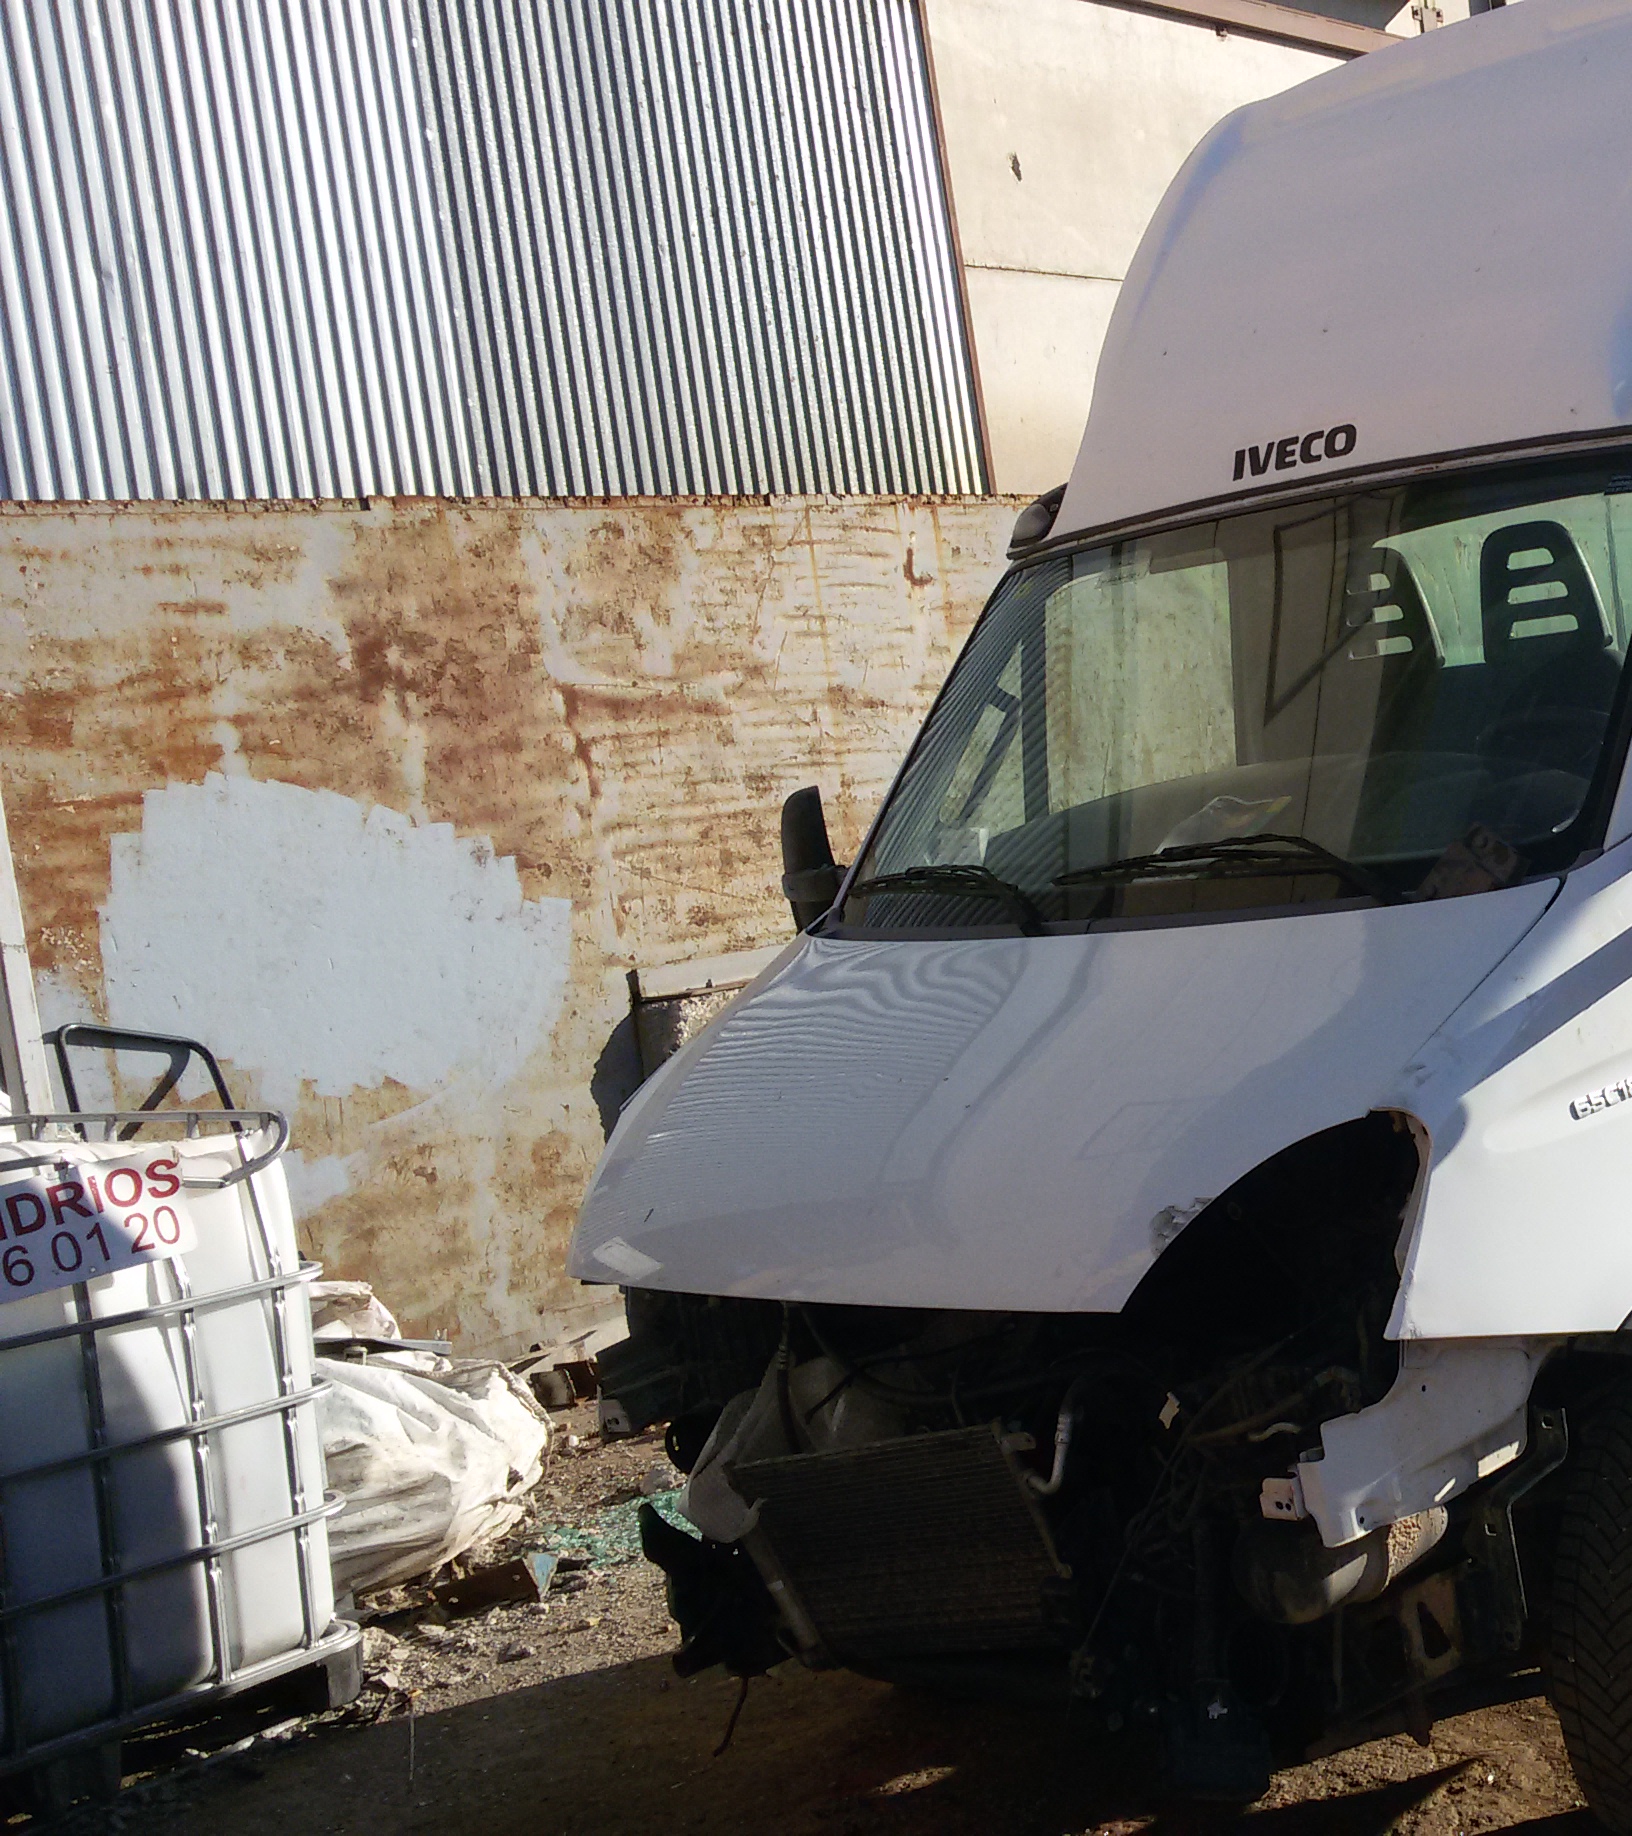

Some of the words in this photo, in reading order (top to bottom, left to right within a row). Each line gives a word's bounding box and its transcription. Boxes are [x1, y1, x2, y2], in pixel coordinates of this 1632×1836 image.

[1232, 423, 1357, 482] IVECO
[2, 1245, 35, 1287] 6
[51, 1222, 110, 1273] 01
[124, 1205, 180, 1254] 20
